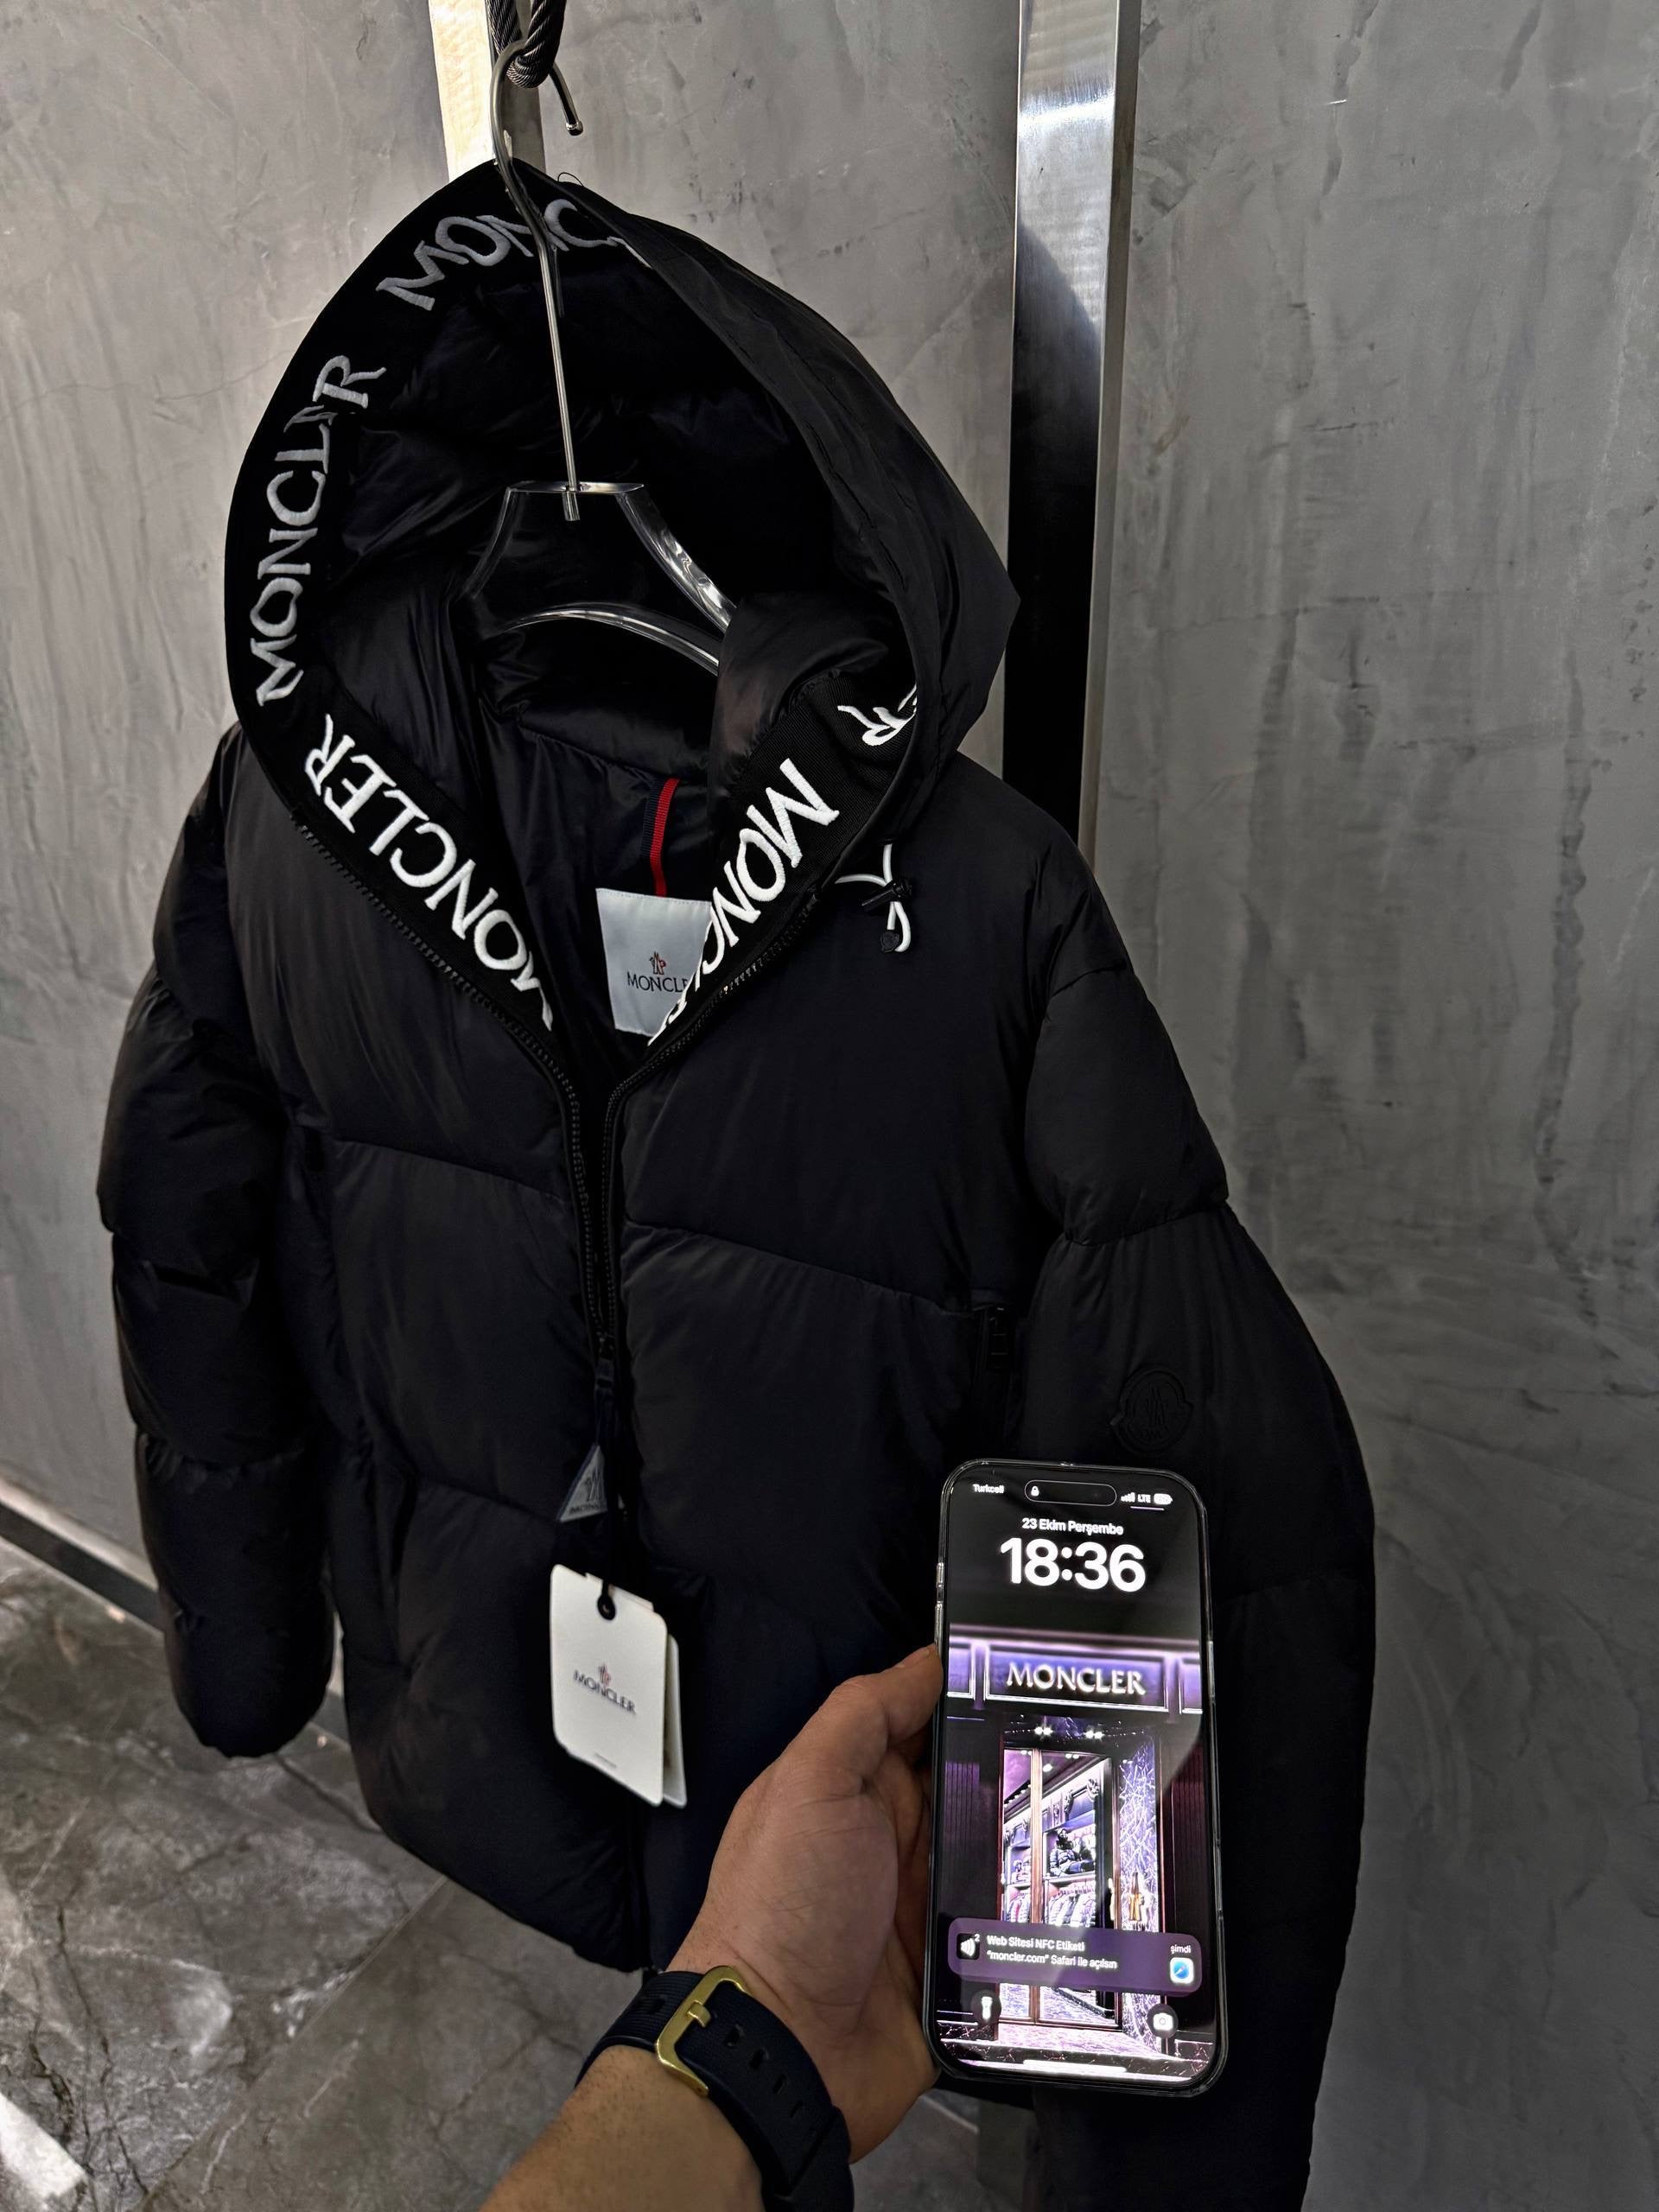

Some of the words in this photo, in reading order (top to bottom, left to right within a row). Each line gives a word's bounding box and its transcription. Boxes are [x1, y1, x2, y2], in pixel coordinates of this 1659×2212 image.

[972, 1483, 1005, 1495] Turkcell
[1137, 1493, 1152, 1503] LTE
[1021, 1517, 1038, 1530] 23
[1039, 1518, 1066, 1532] Ekim
[1068, 1520, 1124, 1536] Perşembe
[1000, 1537, 1147, 1592] 18:36
[1006, 1661, 1147, 1696] MONCLER
[573, 1669, 637, 1715] MONCLER
[986, 1935, 1008, 1946] Web
[1008, 1936, 1034, 1948] Sitesi
[1035, 1939, 1055, 1950] NFC
[1056, 1941, 1085, 1952] Etiketi
[1170, 1943, 1192, 1955] şimdi
[1051, 1955, 1077, 1966] Safari
[1077, 1956, 1088, 1967] ile
[1089, 1958, 1118, 1970] açılsın
